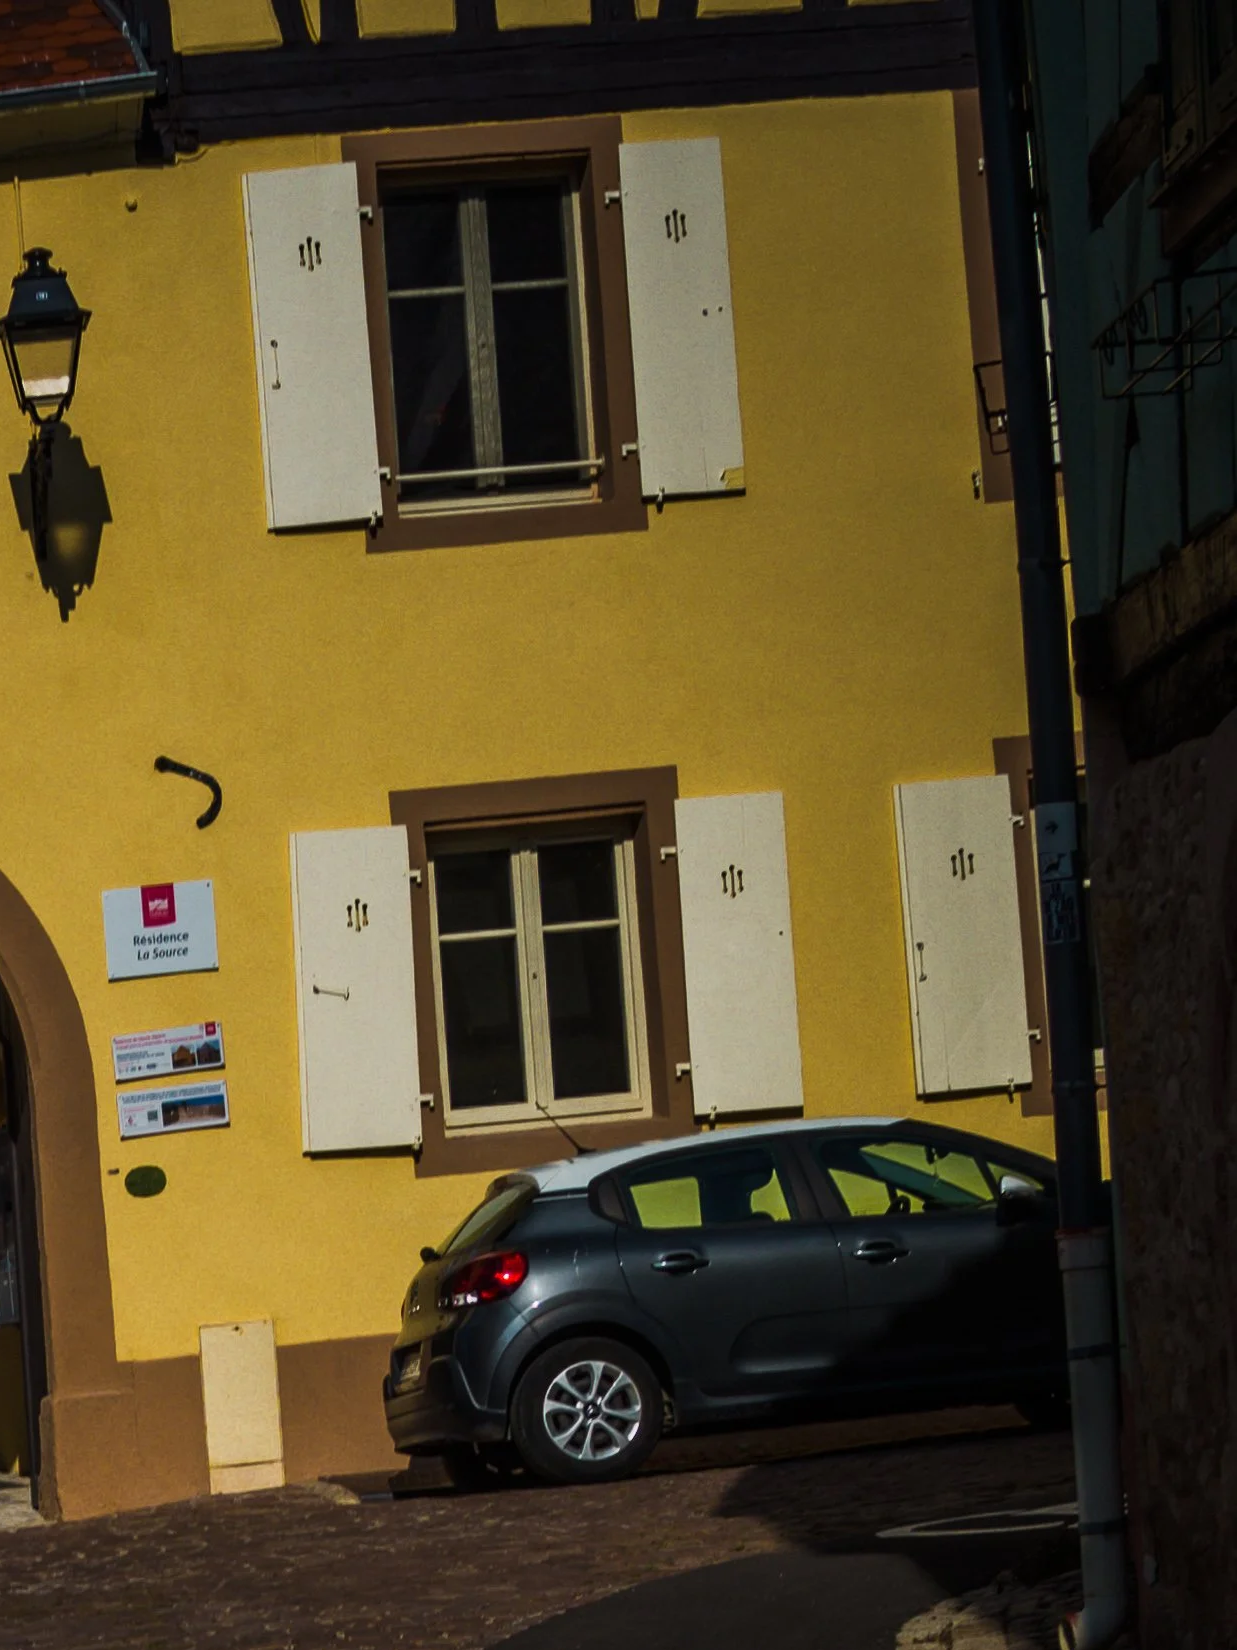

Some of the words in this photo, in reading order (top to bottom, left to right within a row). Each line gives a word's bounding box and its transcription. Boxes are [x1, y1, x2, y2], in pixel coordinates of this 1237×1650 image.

[133, 931, 189, 947] Résidence
[137, 950, 150, 961] La
[152, 946, 189, 960] Source
